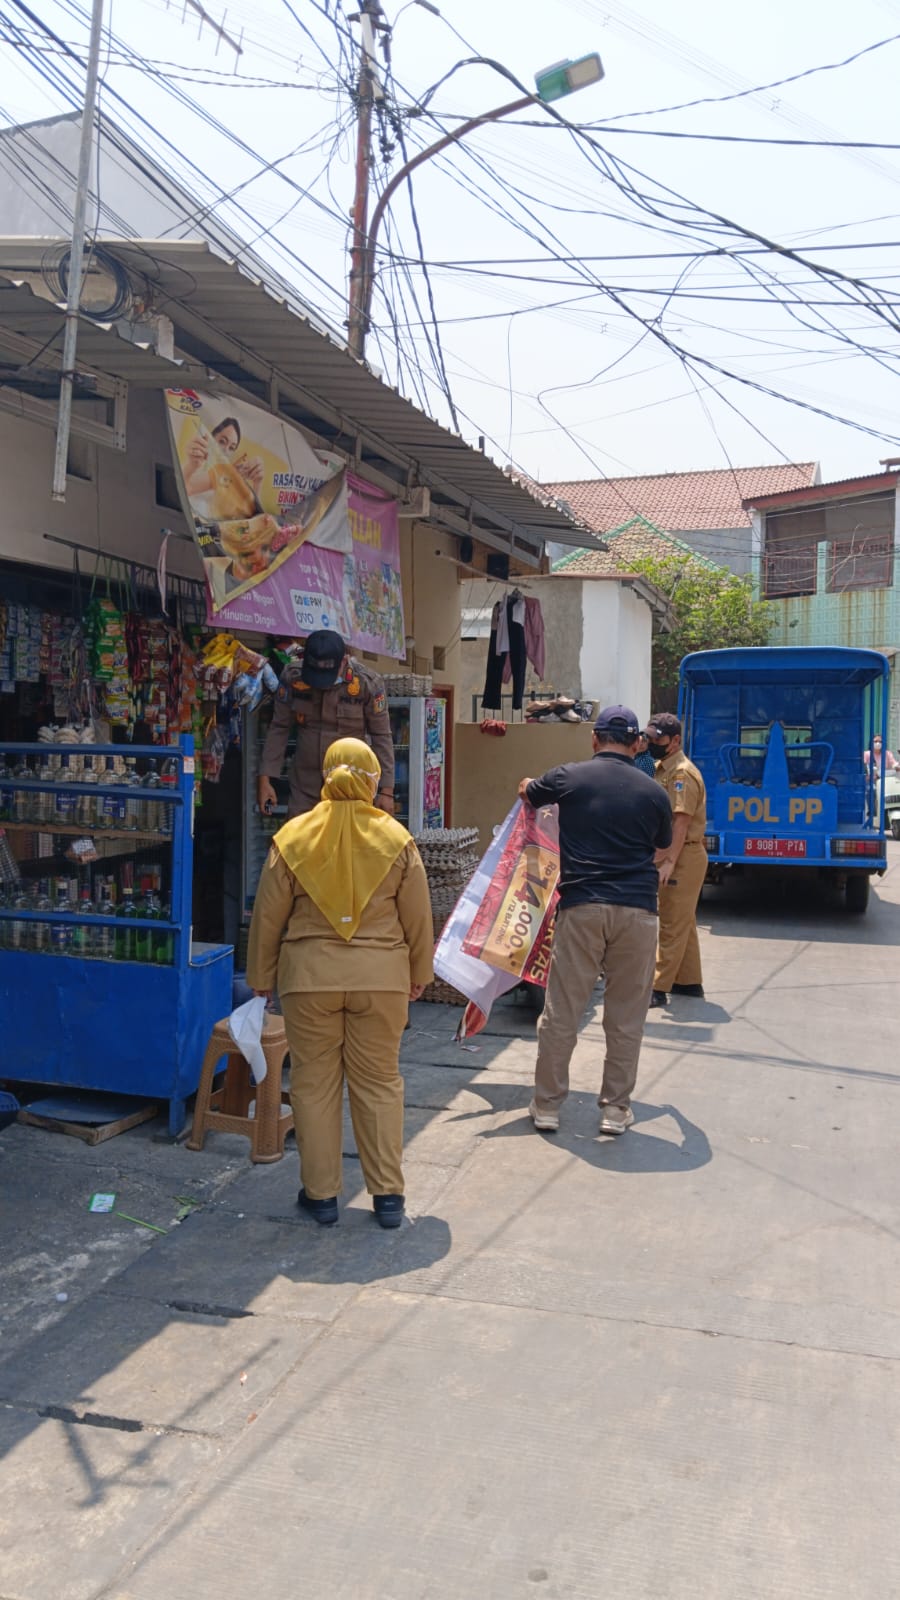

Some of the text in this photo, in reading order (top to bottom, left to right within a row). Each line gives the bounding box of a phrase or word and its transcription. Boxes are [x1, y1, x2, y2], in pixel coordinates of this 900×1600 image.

[296, 611, 314, 625] OVO
[728, 797, 823, 824] POL PP
[746, 839, 753, 851] B
[787, 840, 804, 853] PTA
[544, 861, 558, 877] Rp
